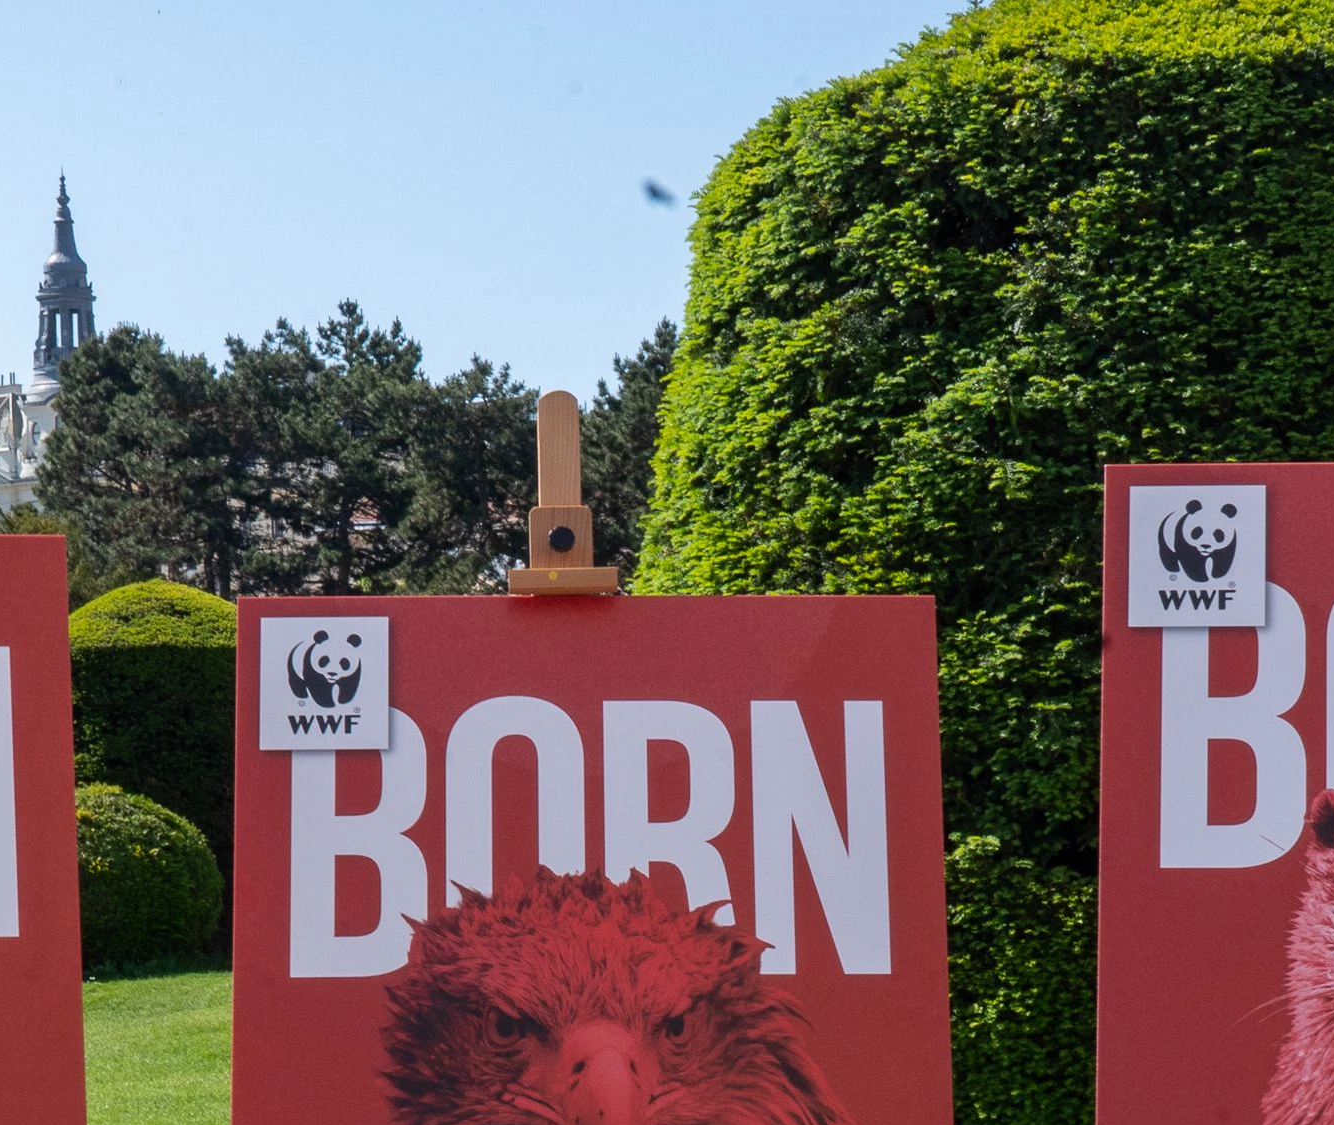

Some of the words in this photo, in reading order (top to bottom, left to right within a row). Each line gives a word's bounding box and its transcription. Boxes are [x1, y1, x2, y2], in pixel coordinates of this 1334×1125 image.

[1158, 589, 1236, 611] WWF
[288, 715, 361, 735] WWF
[289, 696, 891, 978] BORN
